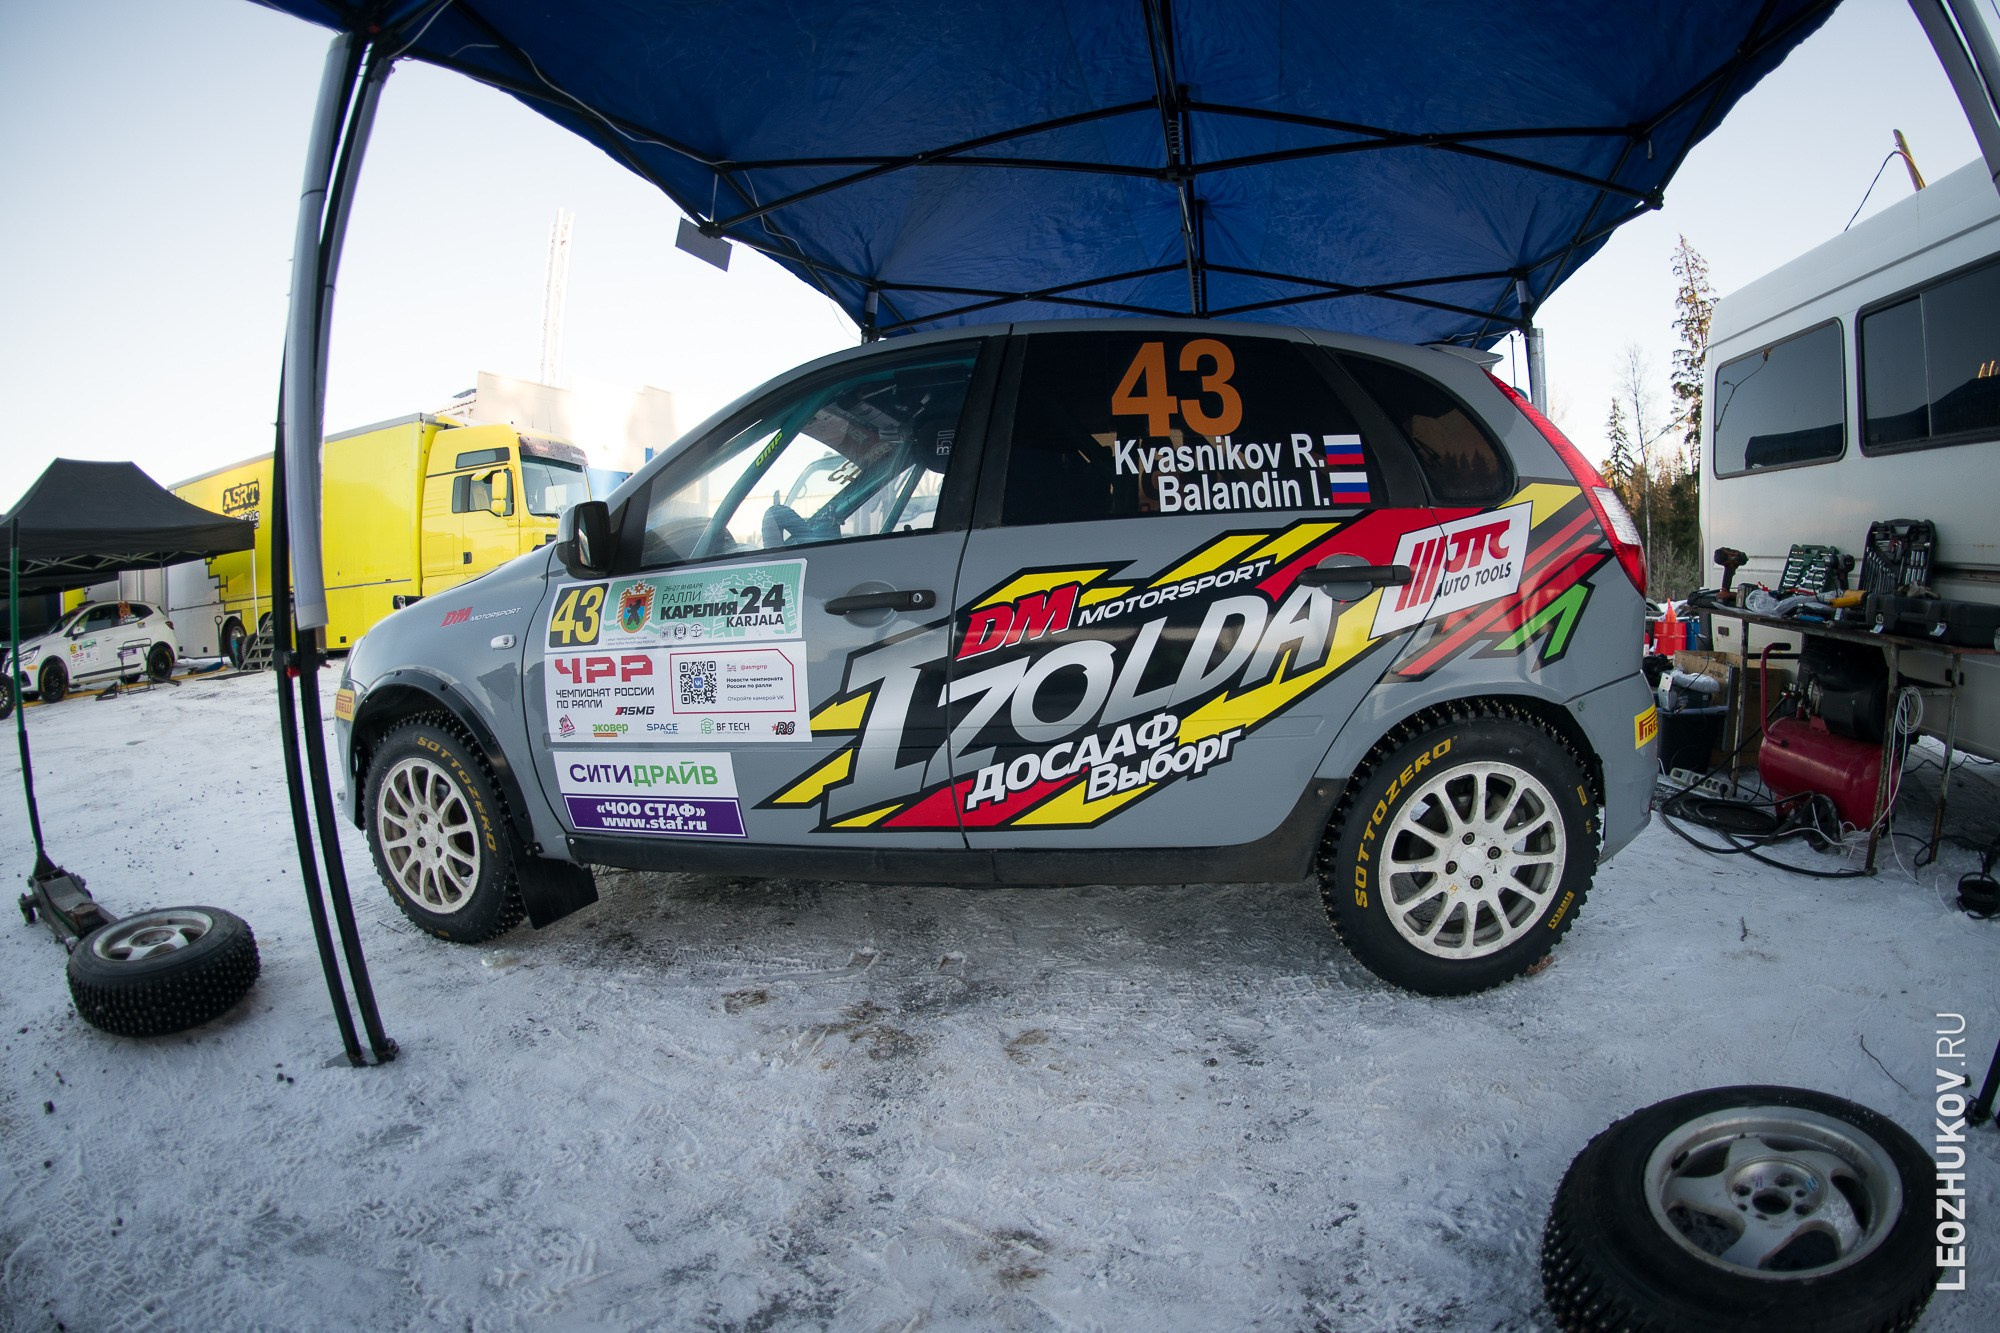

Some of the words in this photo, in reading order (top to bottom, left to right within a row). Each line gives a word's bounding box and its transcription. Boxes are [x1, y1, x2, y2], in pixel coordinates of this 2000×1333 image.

[1112, 338, 1243, 437] 43
[1114, 435, 1281, 475] Kvasnikov
[1290, 433, 1325, 468] R.
[223, 482, 259, 511] ASRT
[1158, 470, 1302, 512] Balandin
[1310, 470, 1330, 506] I.
[1433, 573, 1470, 600] AUTO
[1475, 561, 1512, 587] TOOLS
[659, 601, 738, 620] КАРЕЛИЯ
[661, 590, 702, 604] РАЛЛИ
[440, 606, 473, 627] DM
[469, 607, 521, 622] MOTORSPORT
[551, 587, 604, 645] 43
[726, 614, 784, 627] KARJALA
[954, 586, 1080, 662] DM
[1078, 560, 1271, 627] MOTORSPORT
[554, 654, 653, 684] ЧРР
[556, 688, 611, 698] ЧЕМПИОНАТ
[614, 686, 655, 697] РОССИИ
[556, 700, 569, 709] ПО
[572, 699, 603, 709] РАЛЛИ
[752, 694, 776, 702] камерой
[827, 583, 1334, 820] IZOLDA
[619, 706, 655, 716] ASMG
[646, 723, 678, 731] SPACE
[717, 723, 726, 732] BF
[729, 722, 750, 731] TECH
[569, 761, 719, 787] СИТИДРАЙВ
[966, 713, 1181, 810] ДОСААФ
[1087, 728, 1242, 800] Выборг
[416, 736, 497, 852] SOTTOZERO
[602, 816, 708, 831] www.staf.ru
[644, 803, 706, 818] СТАФ»
[1354, 738, 1452, 909] SOTTOZERO
